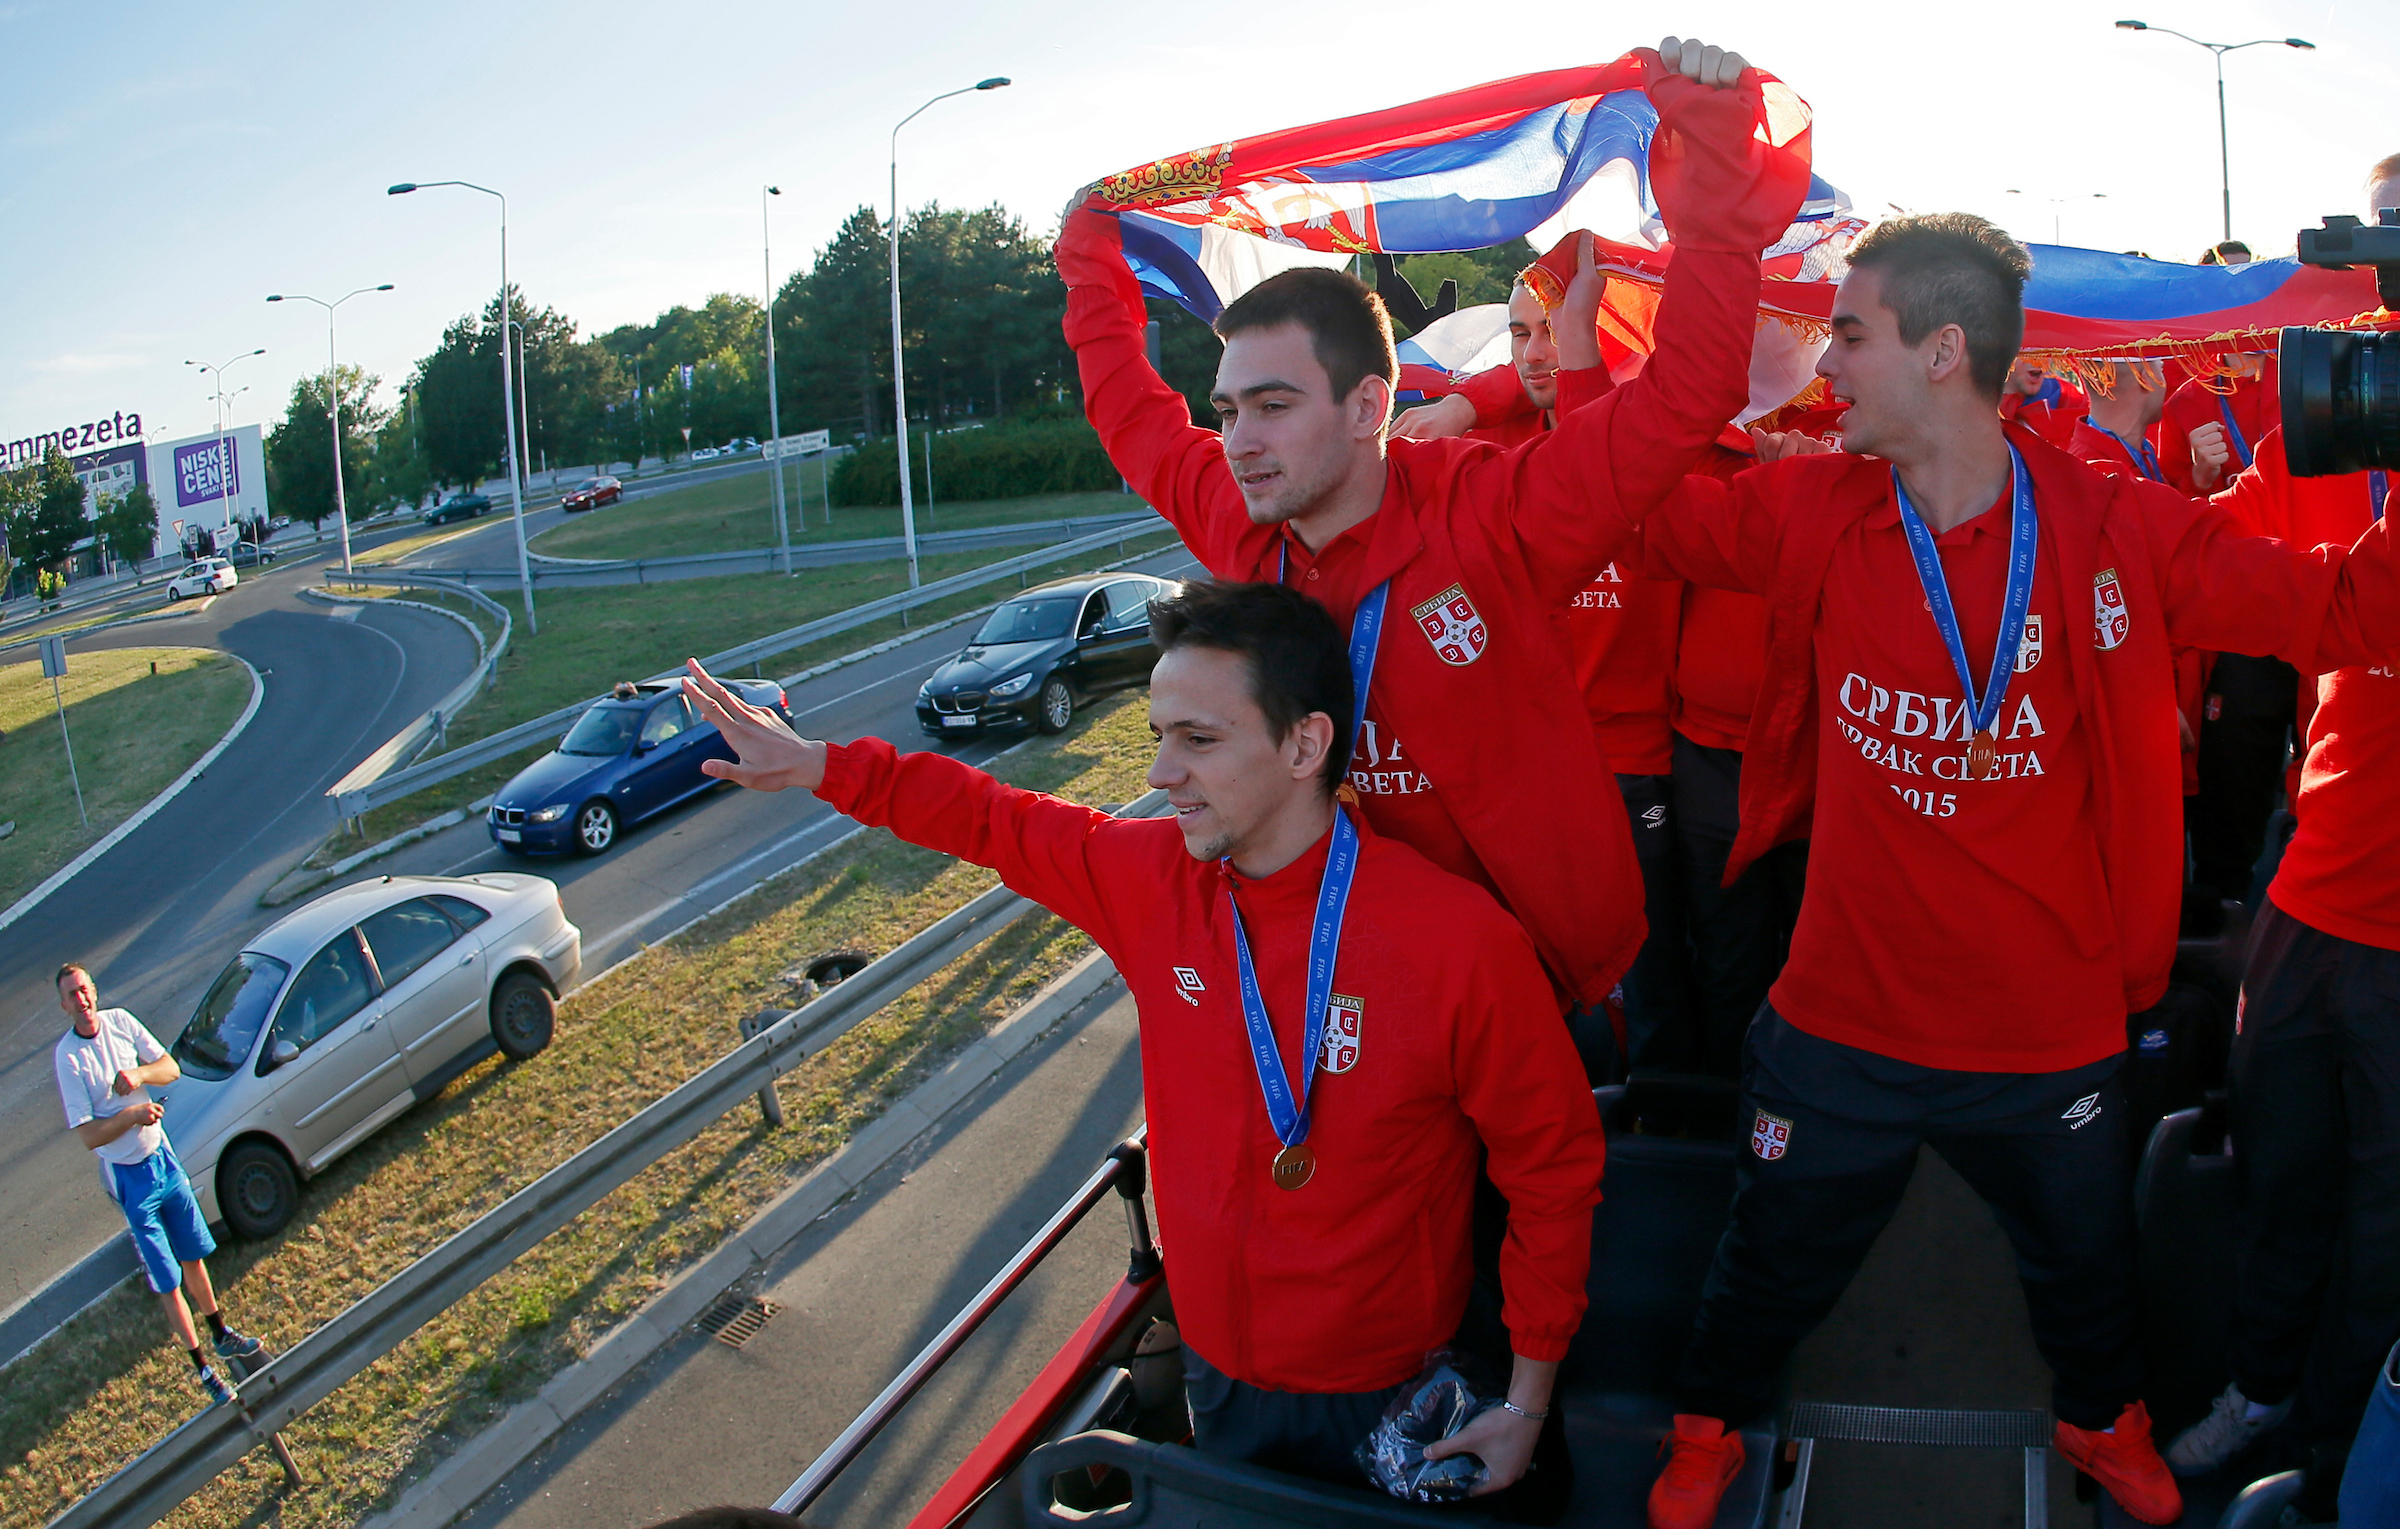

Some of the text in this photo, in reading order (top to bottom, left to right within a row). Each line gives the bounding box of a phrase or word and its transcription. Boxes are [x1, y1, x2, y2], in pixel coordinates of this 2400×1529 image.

[180, 442, 229, 475] NISKE
[184, 460, 232, 494] CENE
[1913, 524, 1922, 544] FIFA
[2022, 521, 2030, 541] FIFA
[1922, 556, 1933, 577] FIFA
[2019, 552, 2027, 573] FIFA
[1414, 588, 1461, 618] СРБИЈА
[1571, 591, 1622, 608] ЕТА
[1932, 589, 1942, 610] FIFA
[2014, 586, 2023, 608] FIFA
[1363, 609, 1374, 631] FIFA
[2007, 620, 2018, 642] FIFA
[1356, 644, 1367, 665] FIFA
[1999, 655, 2010, 676] FIFA
[1836, 716, 1924, 776] РВАК
[1348, 770, 1434, 796] ВЕТА
[1890, 784, 1958, 818] 015
[1336, 852, 1347, 873] FIFA
[1327, 886, 1339, 908] FIFA
[1320, 922, 1331, 944] FIFA
[1317, 957, 1326, 979] FIFA
[1244, 976, 1254, 998] FIFA
[1312, 993, 1322, 1015] FIFA
[1329, 996, 1360, 1010] БИЈА
[1251, 1011, 1262, 1033] FIFA
[1260, 1044, 1272, 1067] FIFA
[1269, 1079, 1282, 1100] FIFA
[2070, 1106, 2102, 1130] umbro
